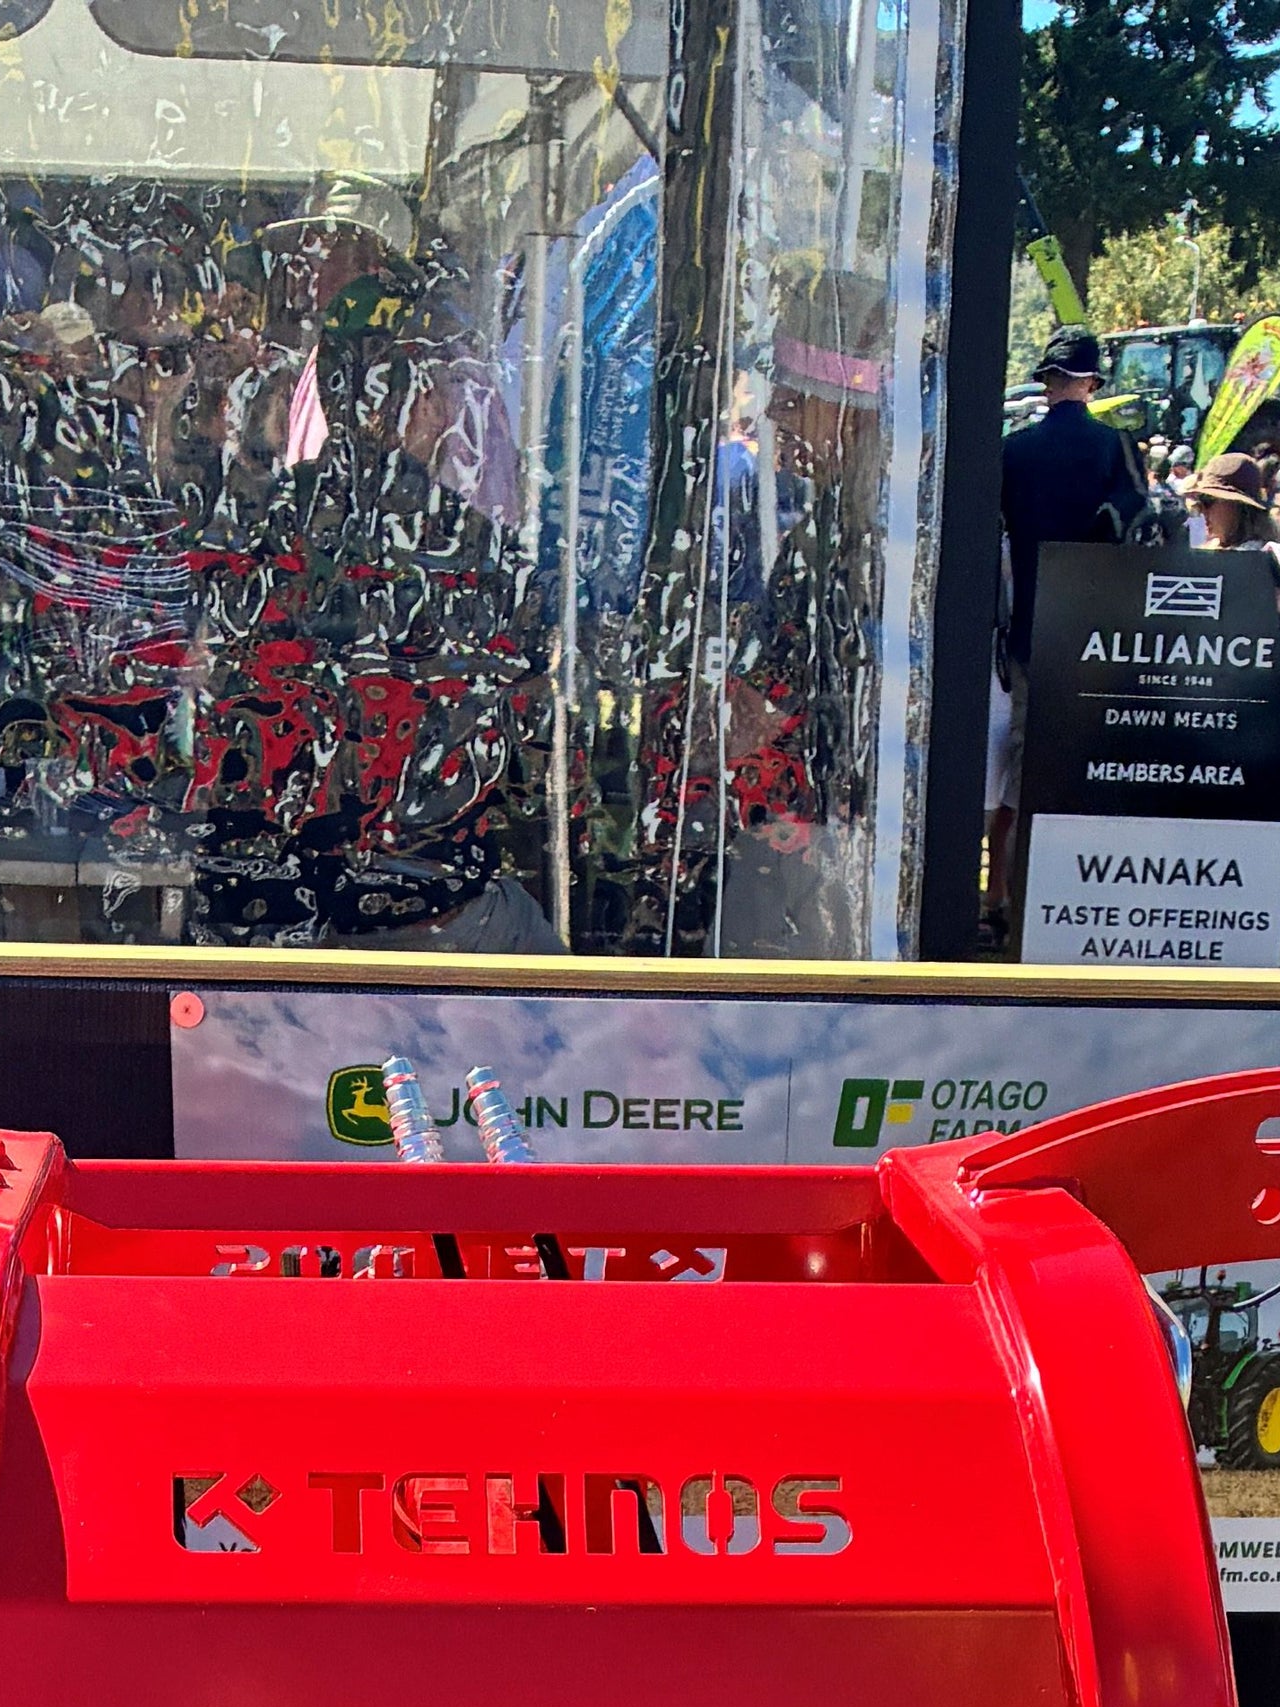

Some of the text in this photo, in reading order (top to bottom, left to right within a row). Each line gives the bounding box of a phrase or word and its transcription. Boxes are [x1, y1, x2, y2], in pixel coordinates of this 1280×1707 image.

[1080, 631, 1274, 668] ALLIANCE
[1139, 674, 1177, 686] SINCE
[1105, 708, 1238, 730] DAWN MEATS
[1087, 761, 1245, 786] MEMBERS AREA
[1077, 854, 1243, 888] WANAKA
[1041, 905, 1270, 931] TASTE OFFERINGS
[1081, 937, 1223, 961] AVAILABLE
[932, 1080, 1048, 1110] OTAGO
[583, 1089, 744, 1131] DEERE
[307, 1471, 852, 1556] TEHNOS
